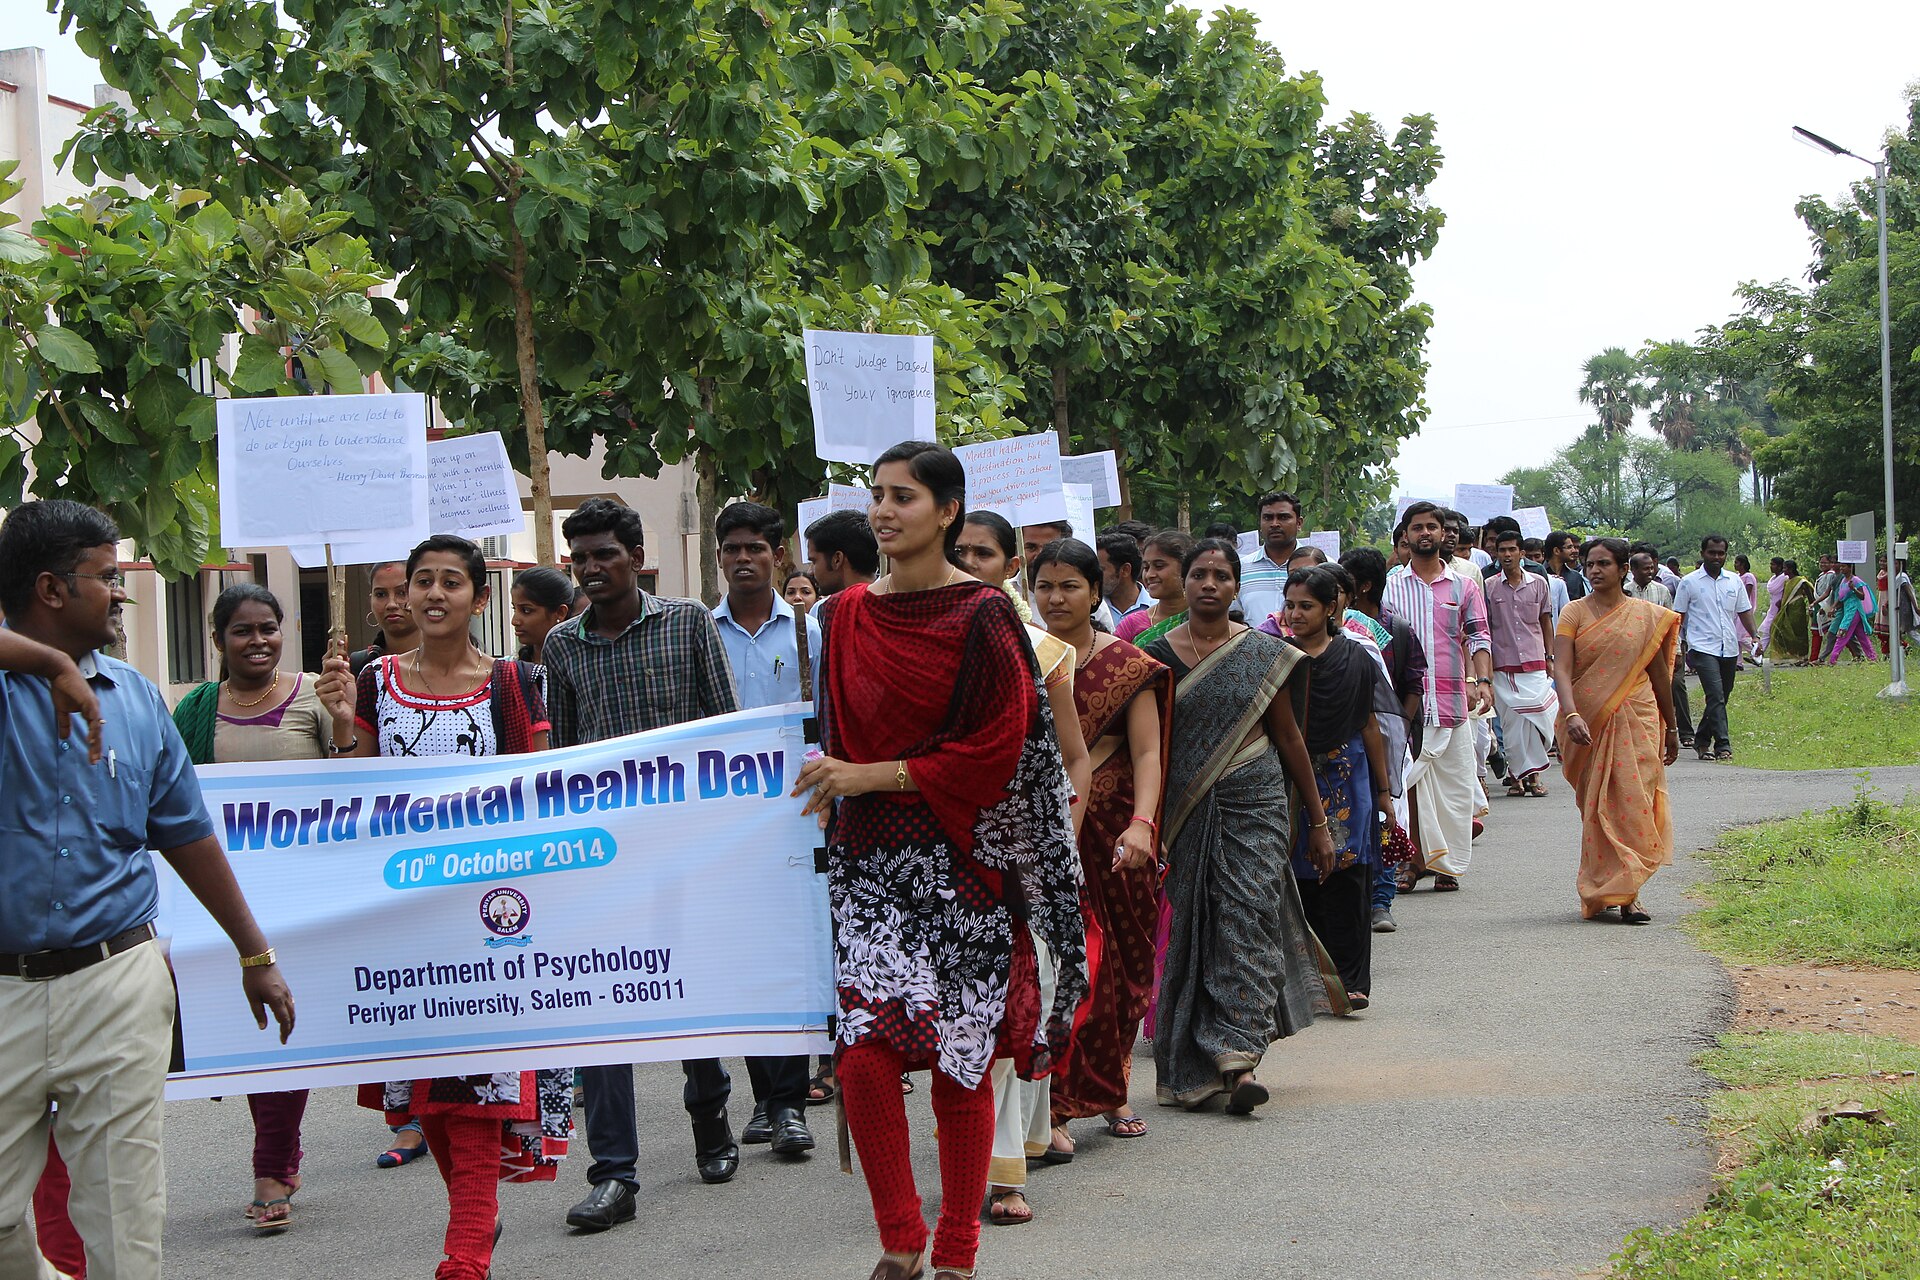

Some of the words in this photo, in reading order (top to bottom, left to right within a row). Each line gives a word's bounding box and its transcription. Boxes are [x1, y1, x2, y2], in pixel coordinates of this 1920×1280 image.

[812, 345, 844, 366] Don't
[855, 350, 888, 371] judge
[896, 354, 930, 374] based
[814, 380, 829, 391] on
[244, 409, 273, 432] Not
[280, 412, 312, 426] until
[317, 414, 335, 424] we
[340, 412, 360, 422] are
[366, 409, 387, 421] lost
[394, 409, 405, 420] to
[246, 439, 259, 452] do
[264, 442, 278, 450] we
[282, 436, 313, 453] begin
[318, 434, 329, 447] to
[965, 447, 996, 462] Mental
[1028, 441, 1035, 449] is
[1037, 436, 1051, 446] not
[431, 455, 446, 467] give
[449, 455, 461, 465] up
[465, 451, 476, 459] on
[442, 469, 460, 479] with
[475, 460, 506, 473] mental
[976, 457, 1025, 473] destination
[1027, 452, 1041, 461] but
[1029, 463, 1053, 474] about
[433, 482, 457, 492] When
[475, 479, 483, 487] is
[972, 491, 987, 501] how
[989, 488, 1001, 499] you
[1028, 479, 1041, 487] not
[441, 496, 450, 505] by
[480, 488, 507, 499] illness
[440, 508, 471, 519] becomes
[477, 503, 511, 514] wellness
[222, 797, 362, 851] World
[369, 776, 525, 838] Mental
[535, 755, 686, 819] Health
[698, 750, 785, 800] Day
[396, 853, 436, 883] 10th
[443, 848, 534, 878] October
[542, 838, 605, 868] 2014
[482, 892, 497, 918] PERIYAR
[497, 890, 528, 915] UNIVERSITY
[497, 925, 519, 933] SALEM
[354, 957, 496, 995] Department
[503, 954, 525, 980] of
[534, 945, 671, 981] Psychology
[347, 1002, 417, 1026] Periyar
[423, 993, 525, 1019] University,
[531, 988, 592, 1011] Salem
[612, 978, 684, 1004] 636011
